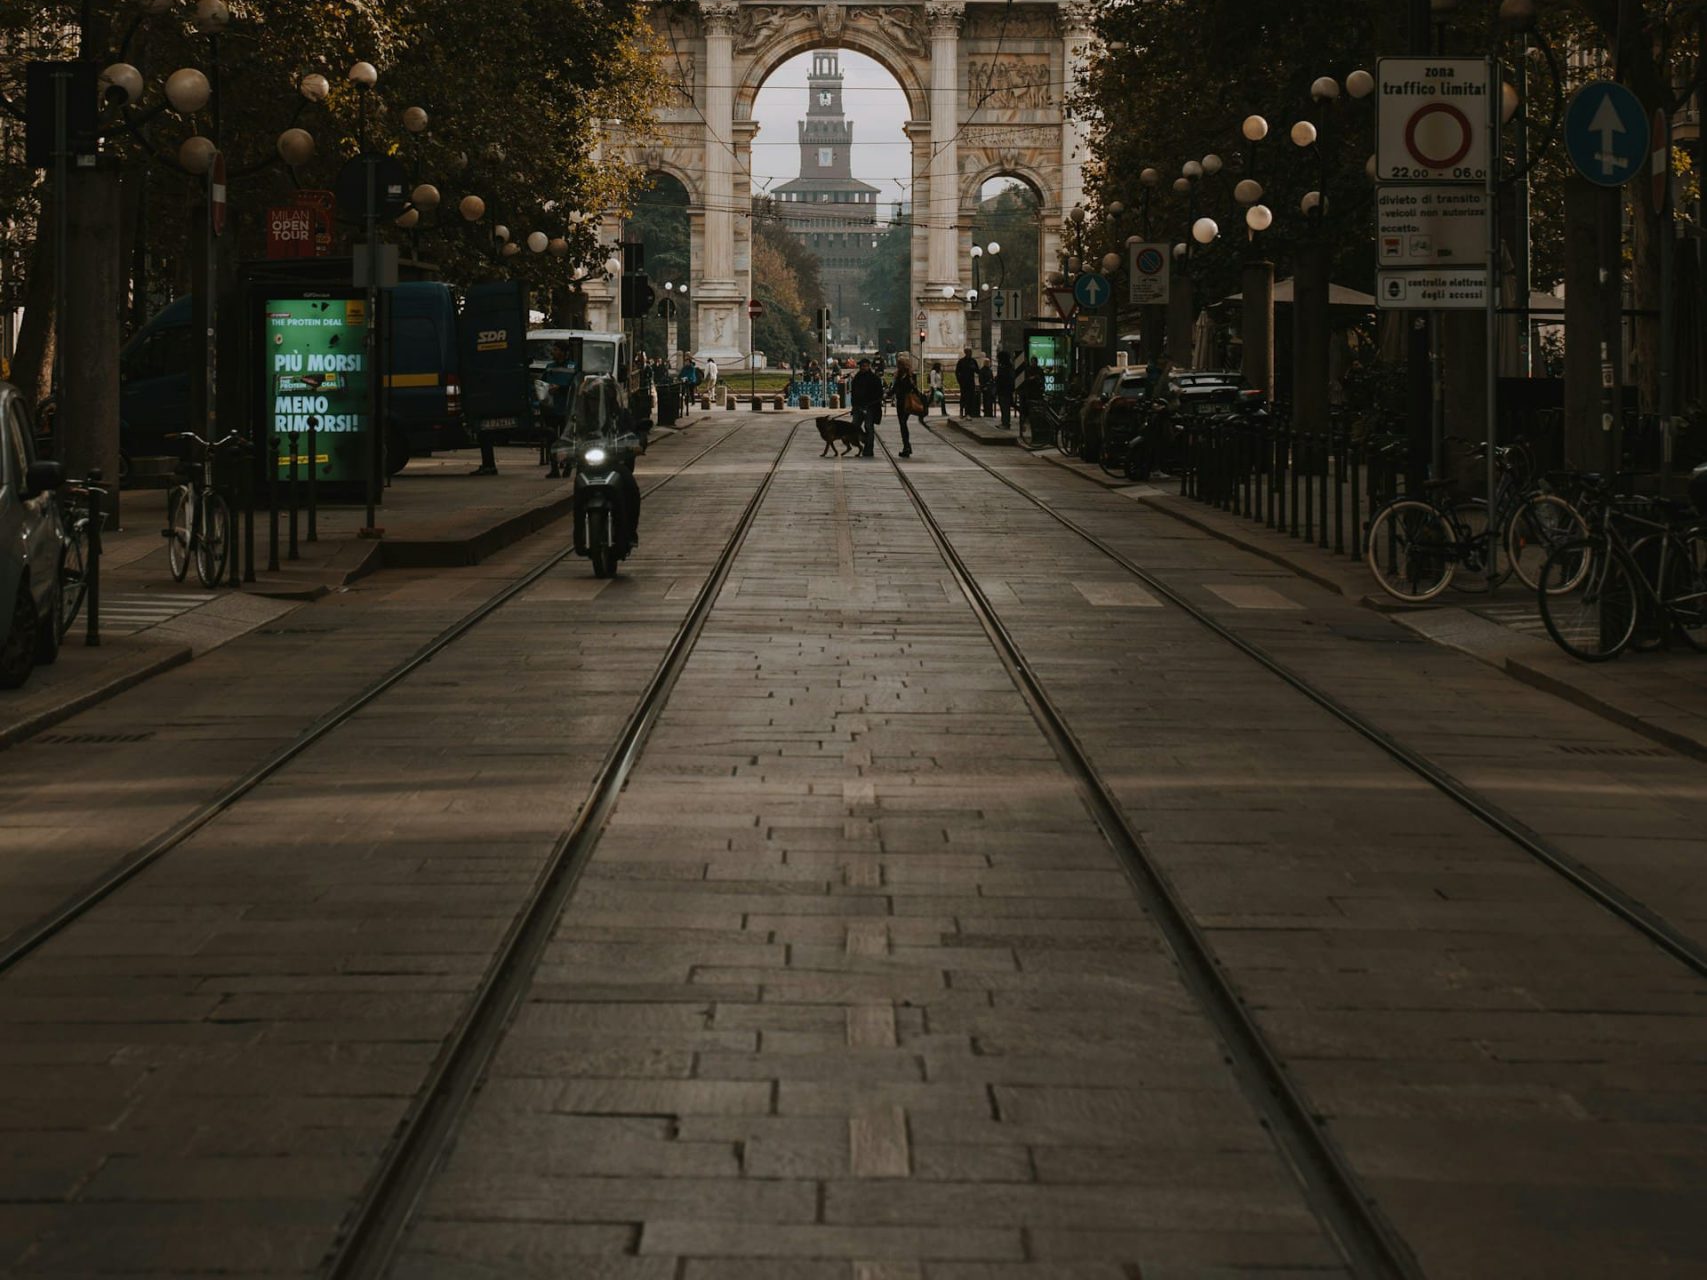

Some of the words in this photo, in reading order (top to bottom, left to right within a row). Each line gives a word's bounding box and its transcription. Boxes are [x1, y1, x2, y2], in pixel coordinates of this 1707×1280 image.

[1425, 67, 1454, 77] zona
[1383, 82, 1436, 95] traffico
[1441, 82, 1486, 95] limitat
[1391, 167, 1428, 179] 22.00
[1379, 194, 1417, 205] divieto
[1421, 195, 1432, 204] di
[1437, 193, 1480, 204] transito
[272, 210, 310, 220] MILAN
[1420, 209, 1438, 217] non
[1442, 208, 1485, 217] autorizza
[272, 221, 310, 231] OPEN
[272, 231, 310, 241] TOUR
[1408, 278, 1447, 287] controllo
[1449, 278, 1486, 287] elettroni
[1421, 290, 1445, 300] degli
[1449, 290, 1483, 299] accessi
[287, 318, 321, 326] PROTEIN
[323, 318, 343, 326] DEAL
[477, 330, 507, 343] SDA
[274, 349, 303, 372] PIÙ
[307, 354, 362, 372] MORSI
[275, 396, 329, 414] MENO
